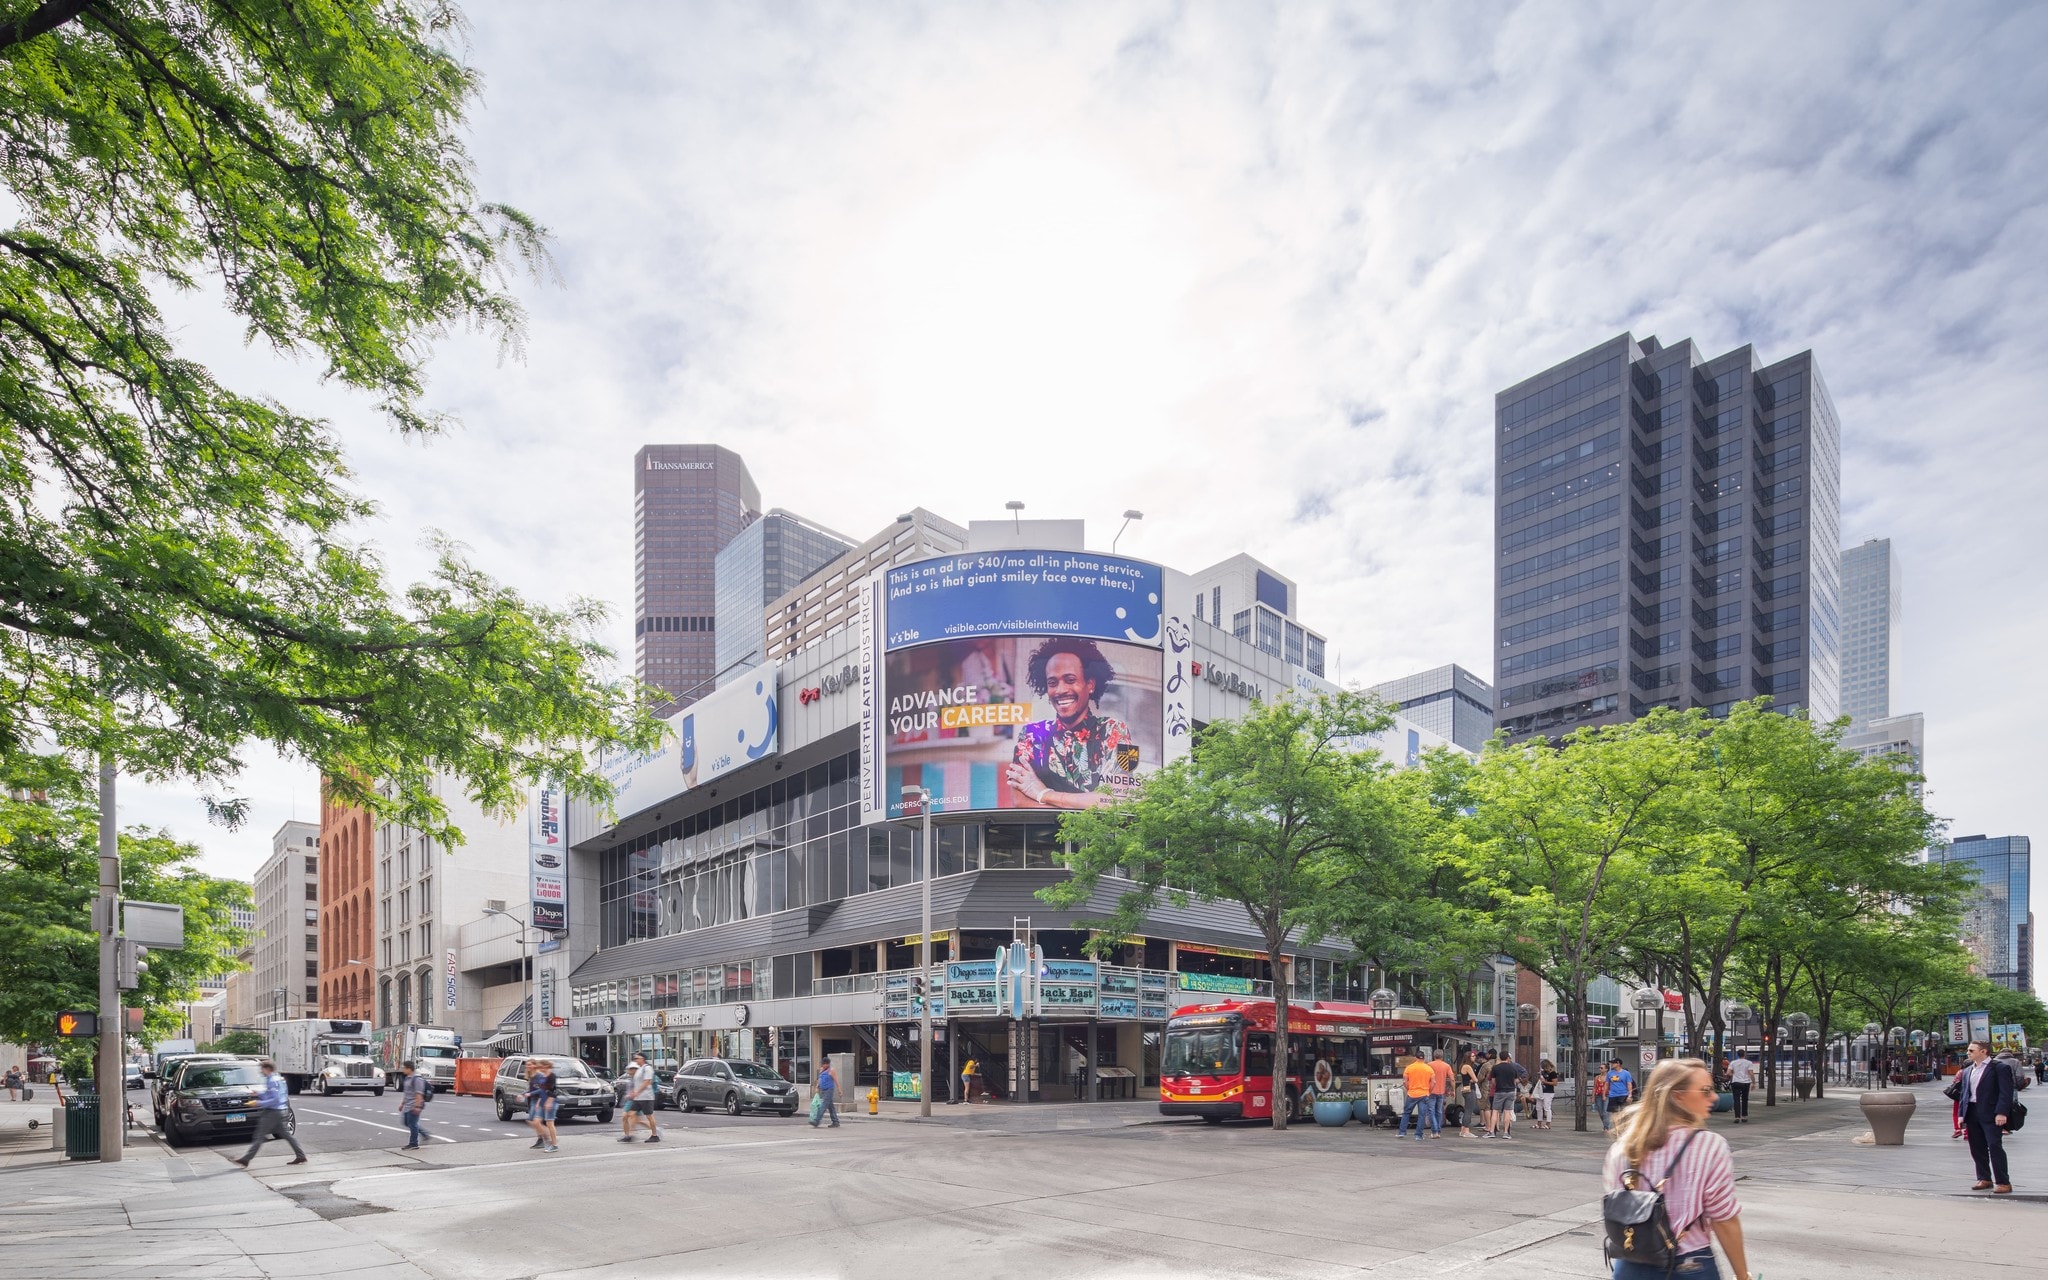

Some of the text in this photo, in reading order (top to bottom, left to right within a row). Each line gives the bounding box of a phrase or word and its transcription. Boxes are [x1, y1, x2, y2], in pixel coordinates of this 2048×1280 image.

[652, 461, 714, 470] TRANSAMERICA
[890, 555, 1144, 585] This is an ad for $40/mo all-in phone service.
[890, 569, 1135, 600] (And so is that giant smiley face over there.)
[944, 619, 1079, 634] visible.com/visibleinthewild
[821, 665, 860, 698] KeyBa
[1205, 661, 1263, 701] KeyBank
[890, 685, 978, 715] ADVANCE
[890, 704, 1031, 735] YOUR CAREER.
[541, 790, 549, 837] SQUARE
[534, 905, 563, 919] Diegos
[950, 965, 977, 980] Diegos
[950, 989, 974, 999] Back
[1069, 988, 1093, 998] East
